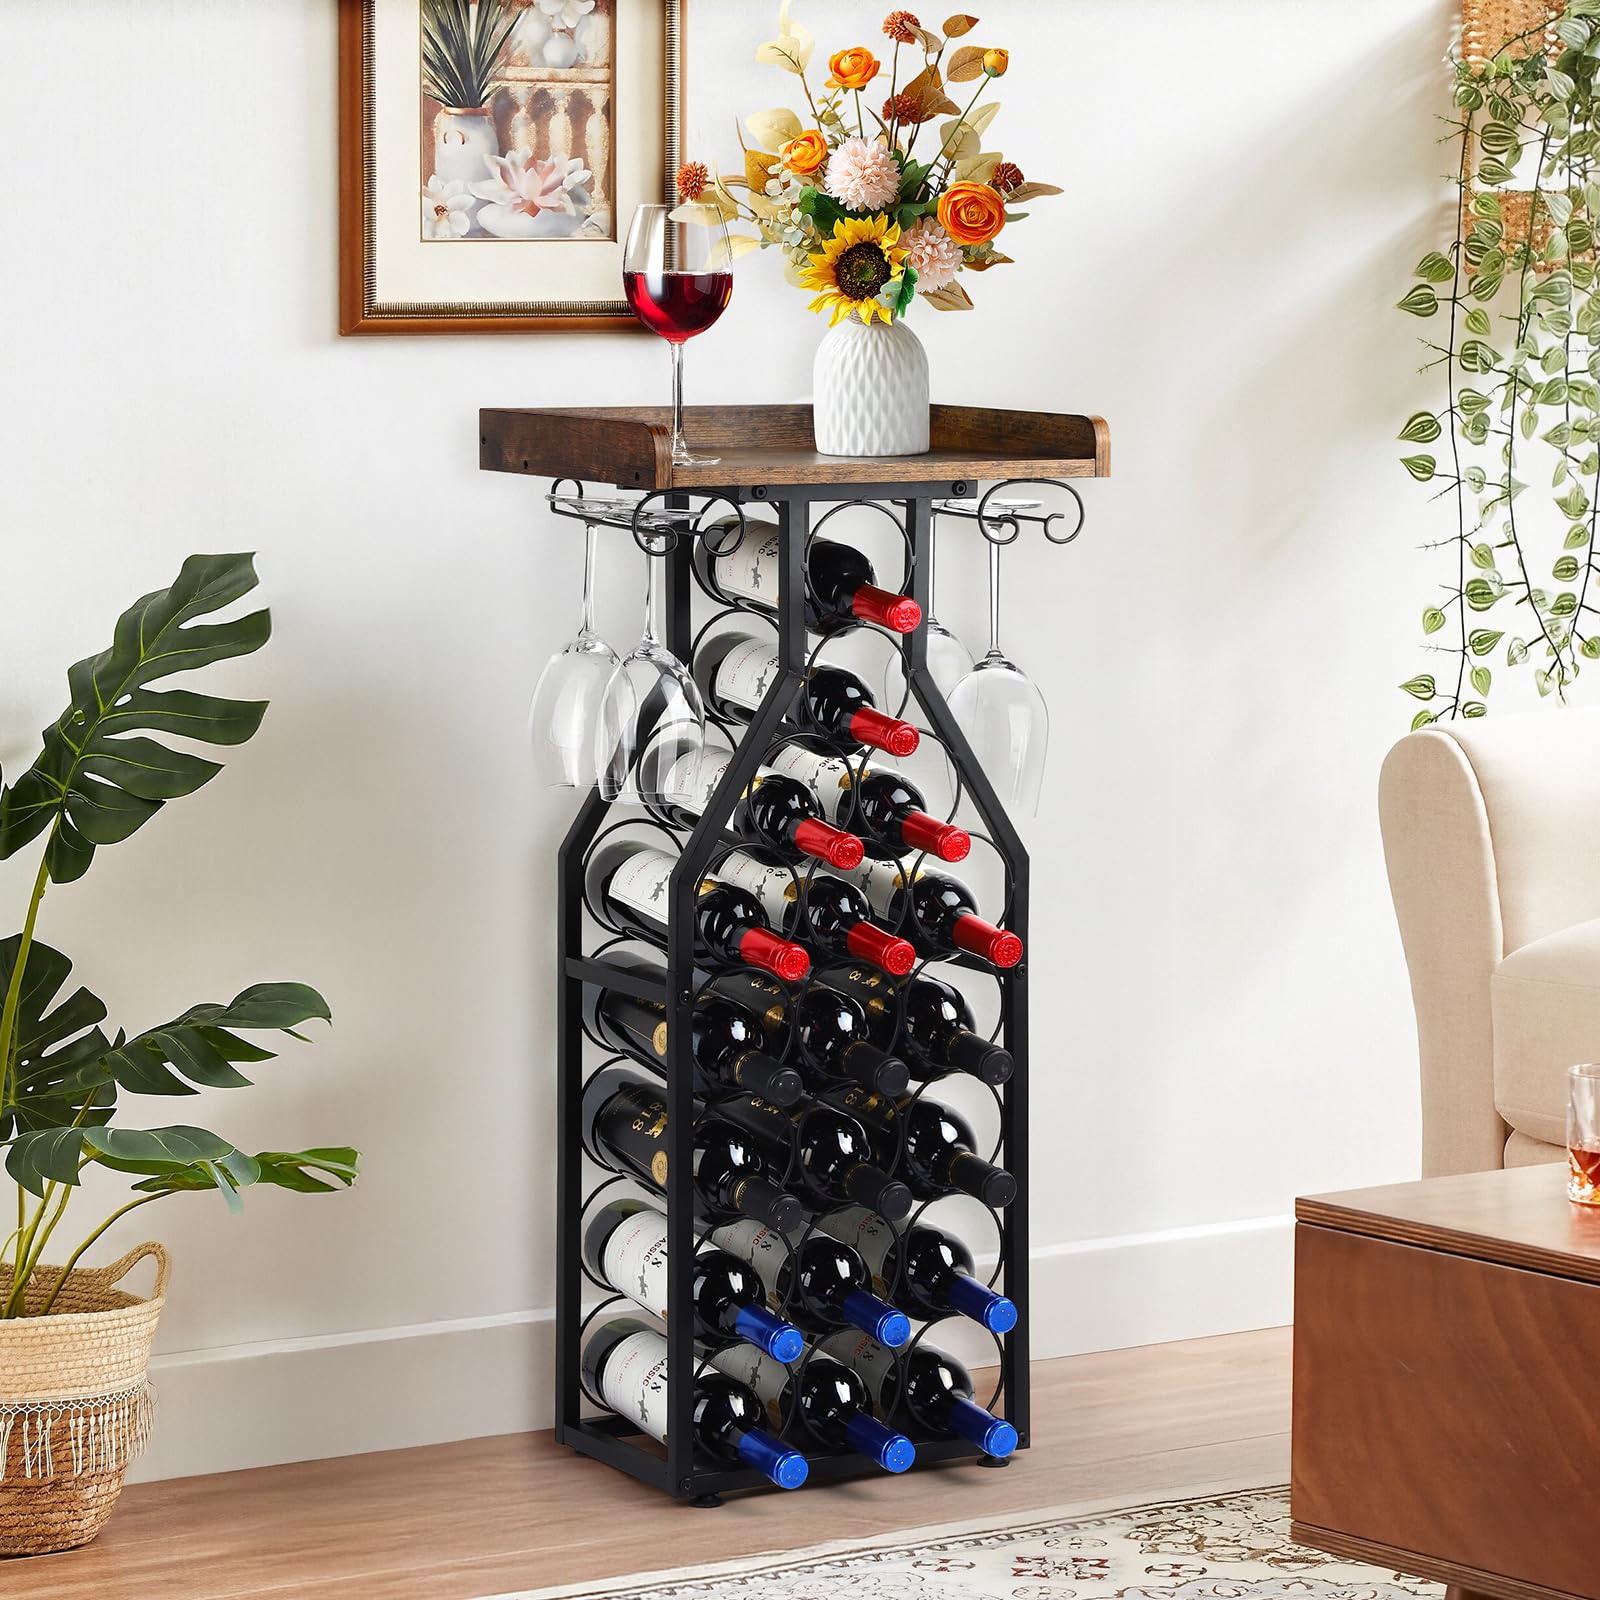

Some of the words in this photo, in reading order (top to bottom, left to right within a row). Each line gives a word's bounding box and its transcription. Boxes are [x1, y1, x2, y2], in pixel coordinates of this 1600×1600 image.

[866, 1219, 885, 1237] 18
[643, 1236, 668, 1263] ASSIC
[760, 1232, 779, 1252] 18
[651, 1249, 669, 1269] 18
[862, 1342, 881, 1362] 18
[642, 1357, 668, 1388] ASSIC
[650, 1372, 668, 1394] 18
